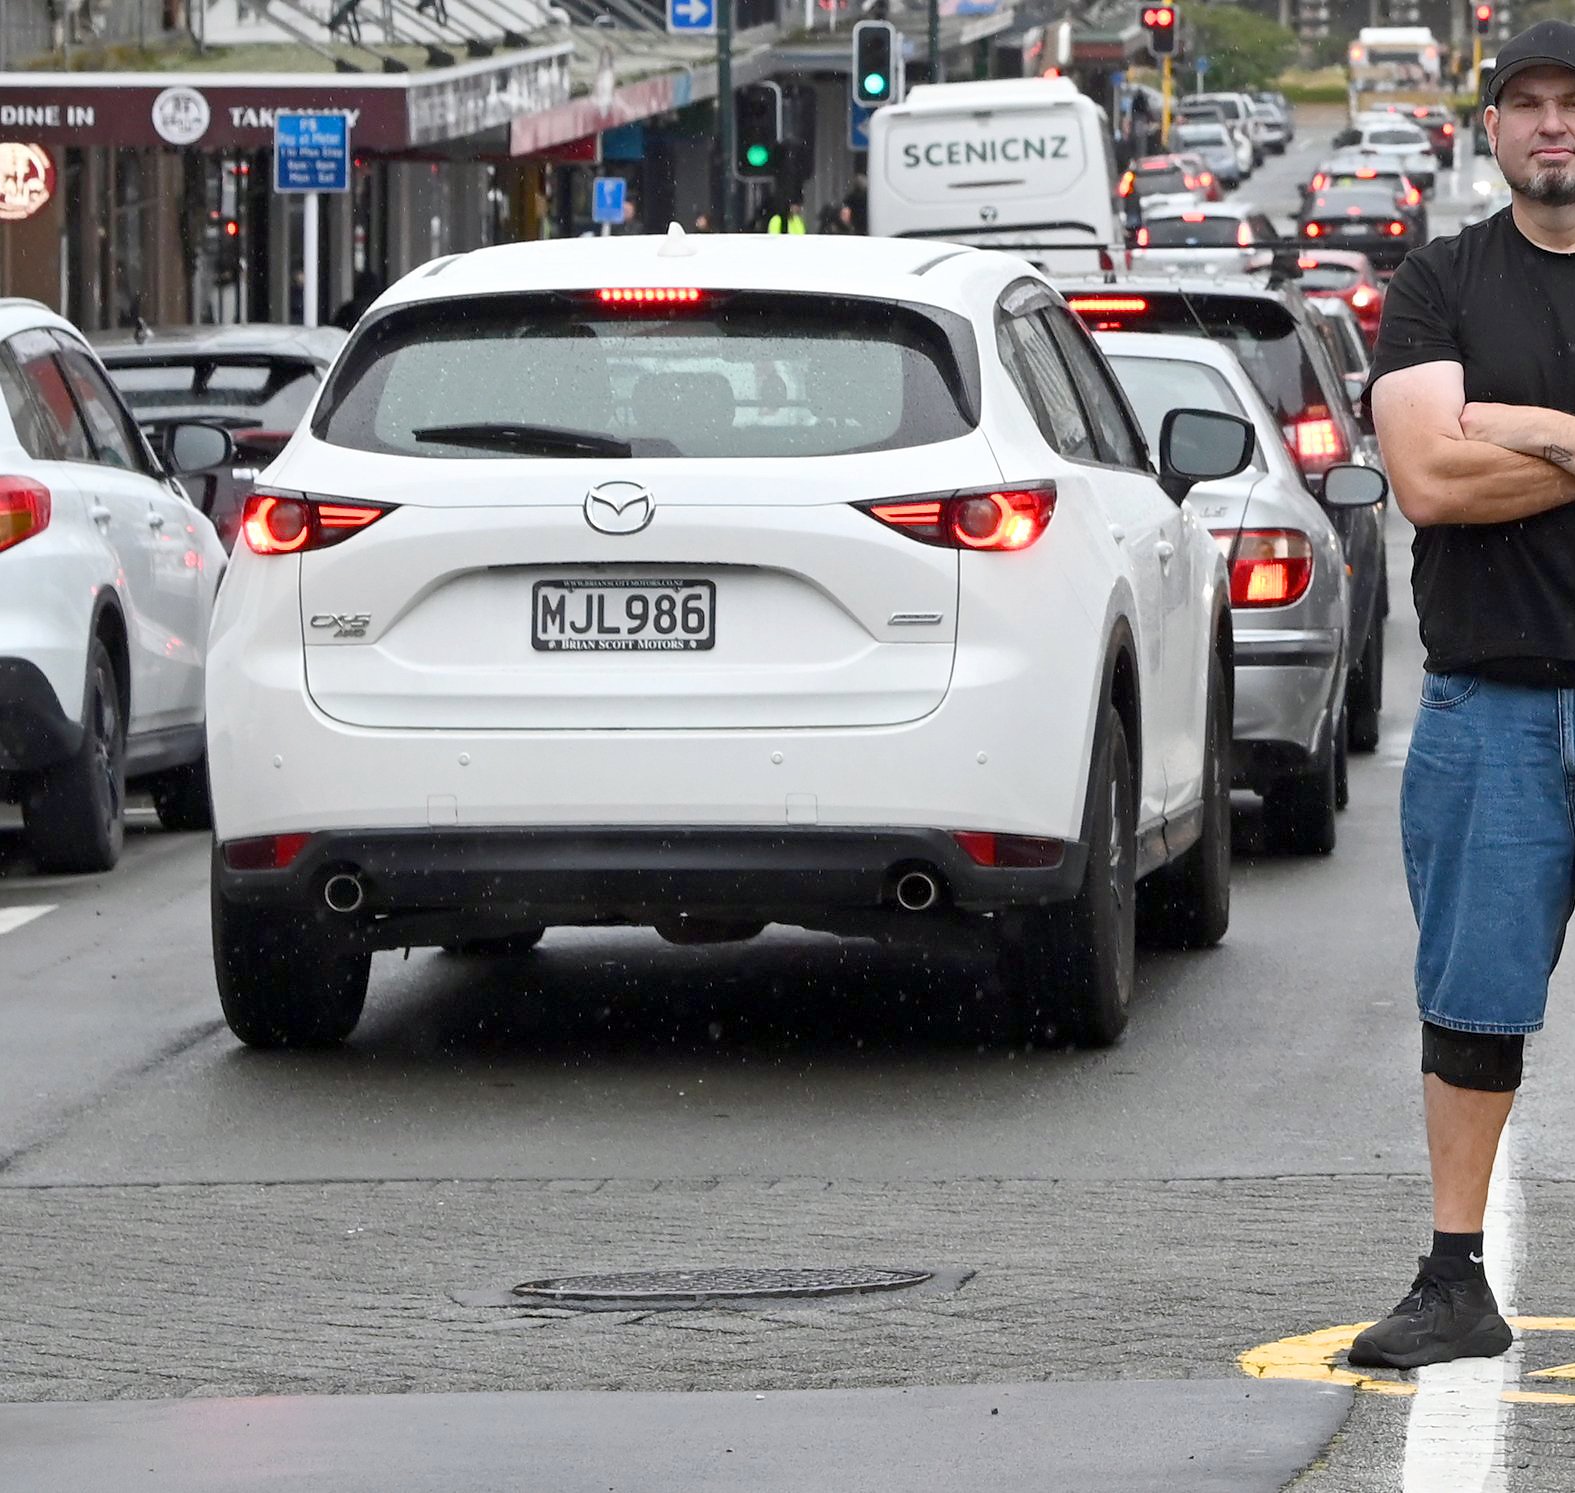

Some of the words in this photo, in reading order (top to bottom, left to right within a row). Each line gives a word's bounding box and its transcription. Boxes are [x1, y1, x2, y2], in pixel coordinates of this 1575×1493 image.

[1, 105, 60, 127] DINE
[67, 106, 95, 127] IN
[229, 107, 360, 128] TAKY
[903, 136, 1070, 168] SCENICNZ
[289, 172, 311, 183] Mon
[310, 612, 372, 631] CX-5
[541, 593, 706, 635] MJL986
[562, 640, 596, 650] BRIAN
[598, 640, 634, 650] SCOTT
[637, 640, 684, 650] MOTORS
